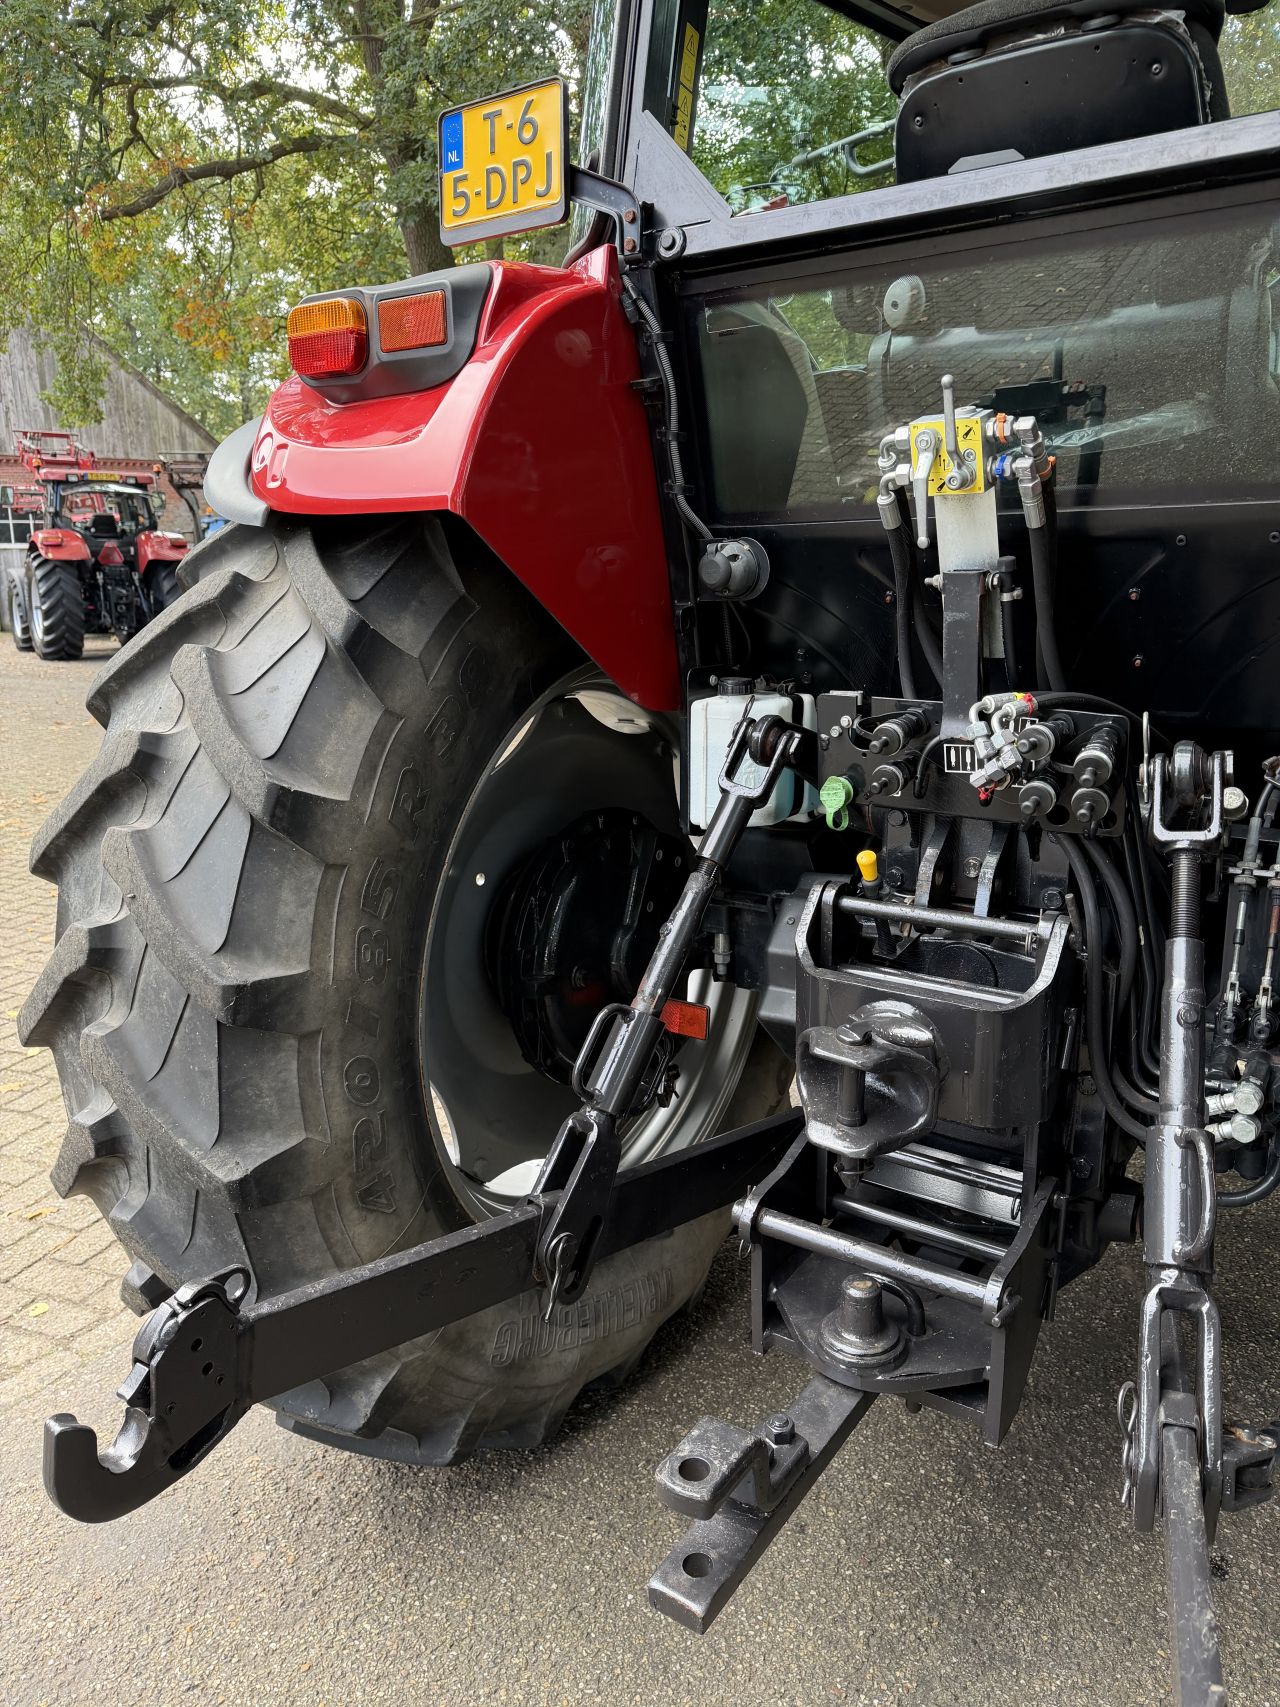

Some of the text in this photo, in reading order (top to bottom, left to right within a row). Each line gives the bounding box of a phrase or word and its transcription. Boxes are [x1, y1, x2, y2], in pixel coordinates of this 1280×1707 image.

[482, 98, 539, 155] T-6
[448, 151, 460, 164] NL
[452, 151, 553, 217] 5-DPJ
[489, 1269, 673, 1368] TRELLEBORG
